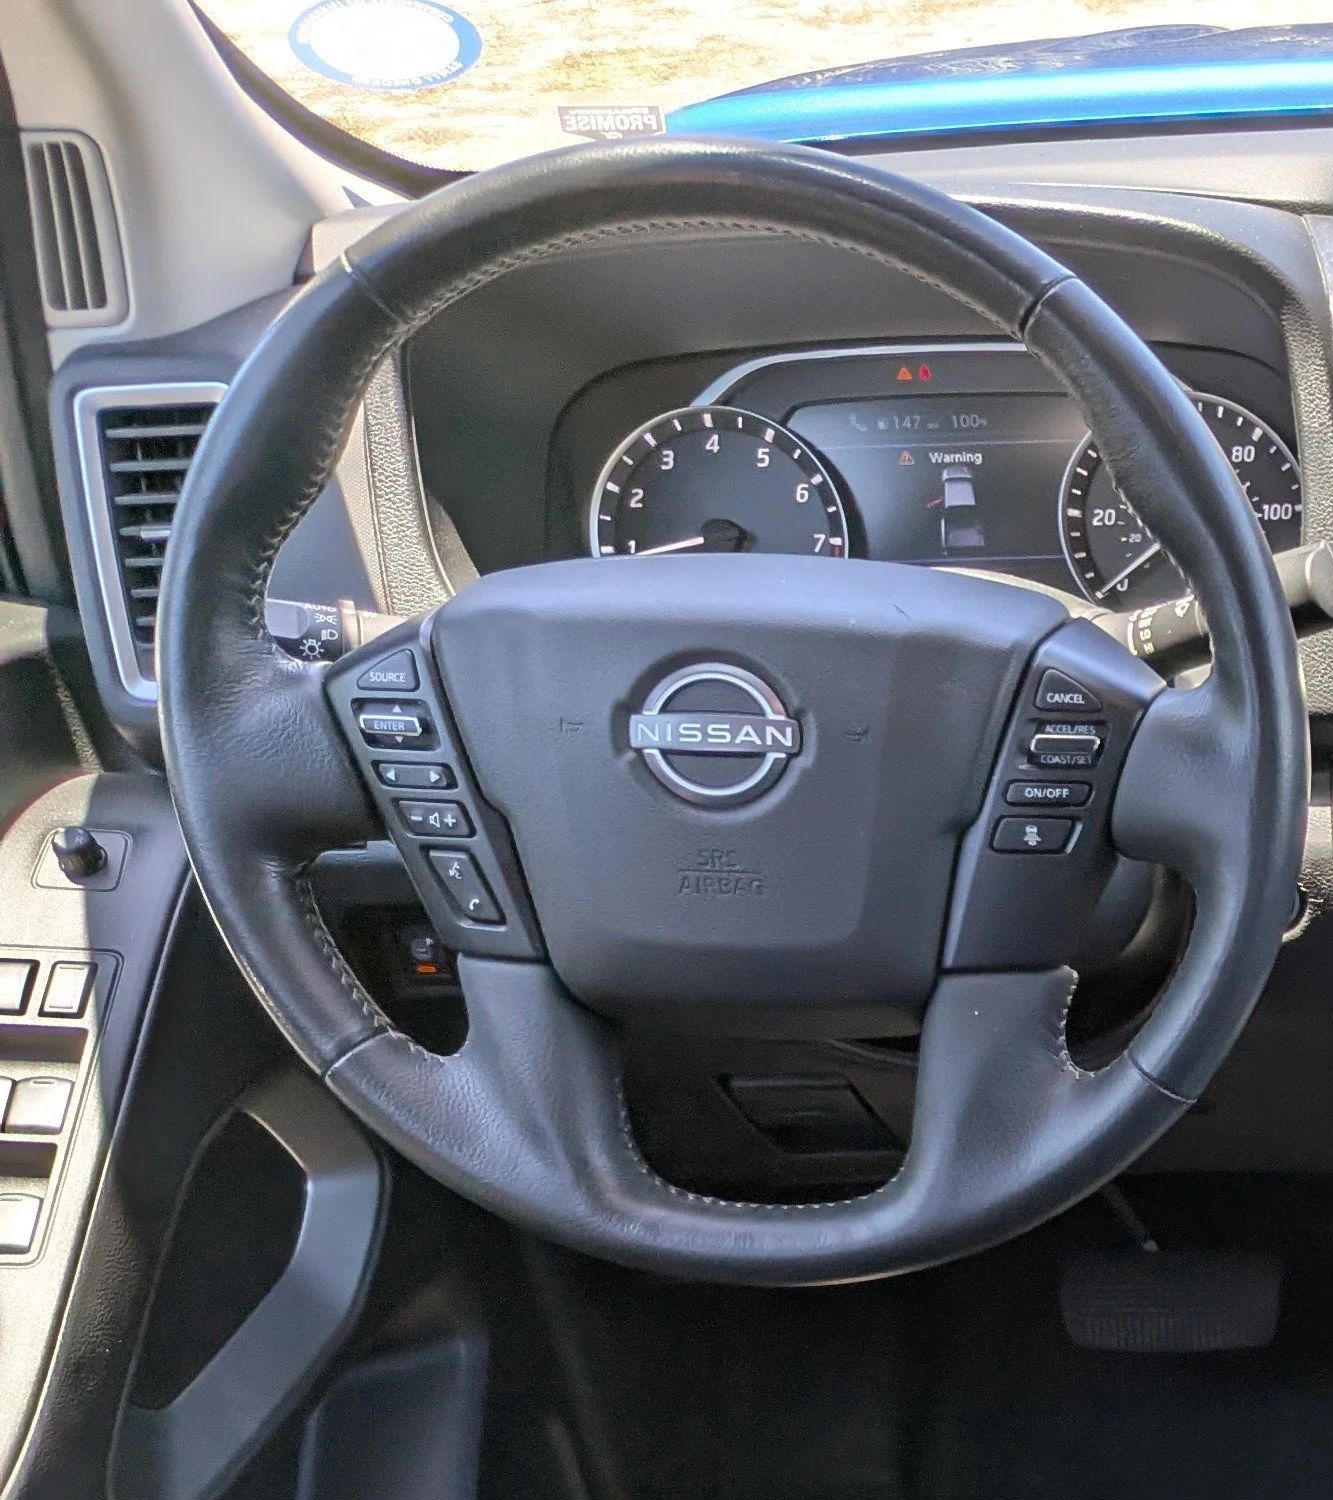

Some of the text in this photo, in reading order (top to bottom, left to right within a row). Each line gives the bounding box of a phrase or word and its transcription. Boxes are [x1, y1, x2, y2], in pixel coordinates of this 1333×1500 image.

[892, 415, 921, 430] 147
[705, 434, 720, 453] 4
[660, 450, 674, 470] 3
[756, 448, 770, 468] 5
[928, 451, 983, 465] Warning
[1231, 445, 1255, 463] 80
[629, 488, 643, 508] 2
[795, 483, 809, 503] 6
[1092, 509, 1116, 526] 20
[1262, 503, 1292, 521] 100
[628, 539, 636, 555] 1
[813, 533, 826, 552] 7
[369, 671, 406, 683] SOURCE
[1046, 693, 1085, 705] CANCEL
[374, 720, 405, 731] ENTER
[1045, 724, 1096, 735] ACCEL/RES
[637, 723, 793, 747] NISSAN
[1040, 754, 1092, 764] COAST/SET
[1024, 787, 1070, 798] ON/OFF
[678, 876, 764, 895] AIRBAG
